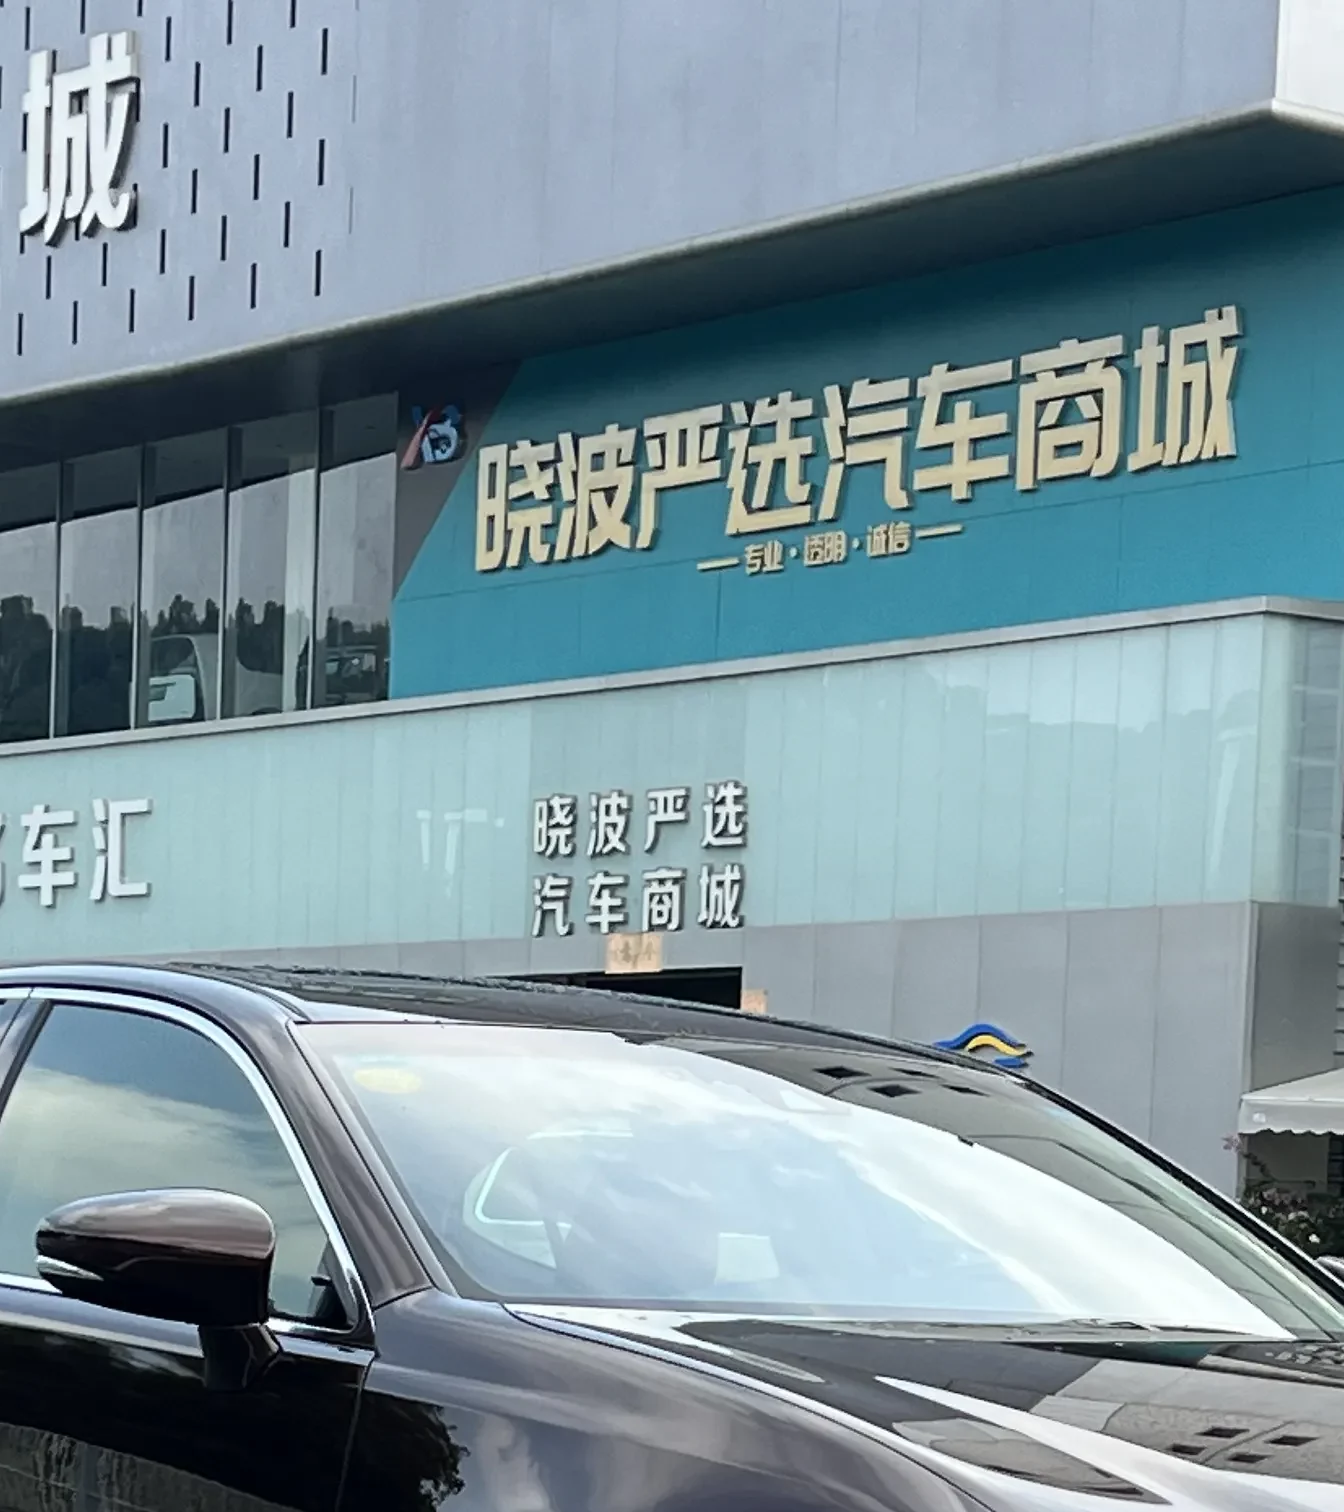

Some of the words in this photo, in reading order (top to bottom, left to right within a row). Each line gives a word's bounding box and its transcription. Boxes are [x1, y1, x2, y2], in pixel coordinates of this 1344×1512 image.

[474, 305, 1244, 571] 晓波严选汽车商城
[532, 780, 749, 858] 晓波严选
[531, 863, 746, 938] 汽车商城
